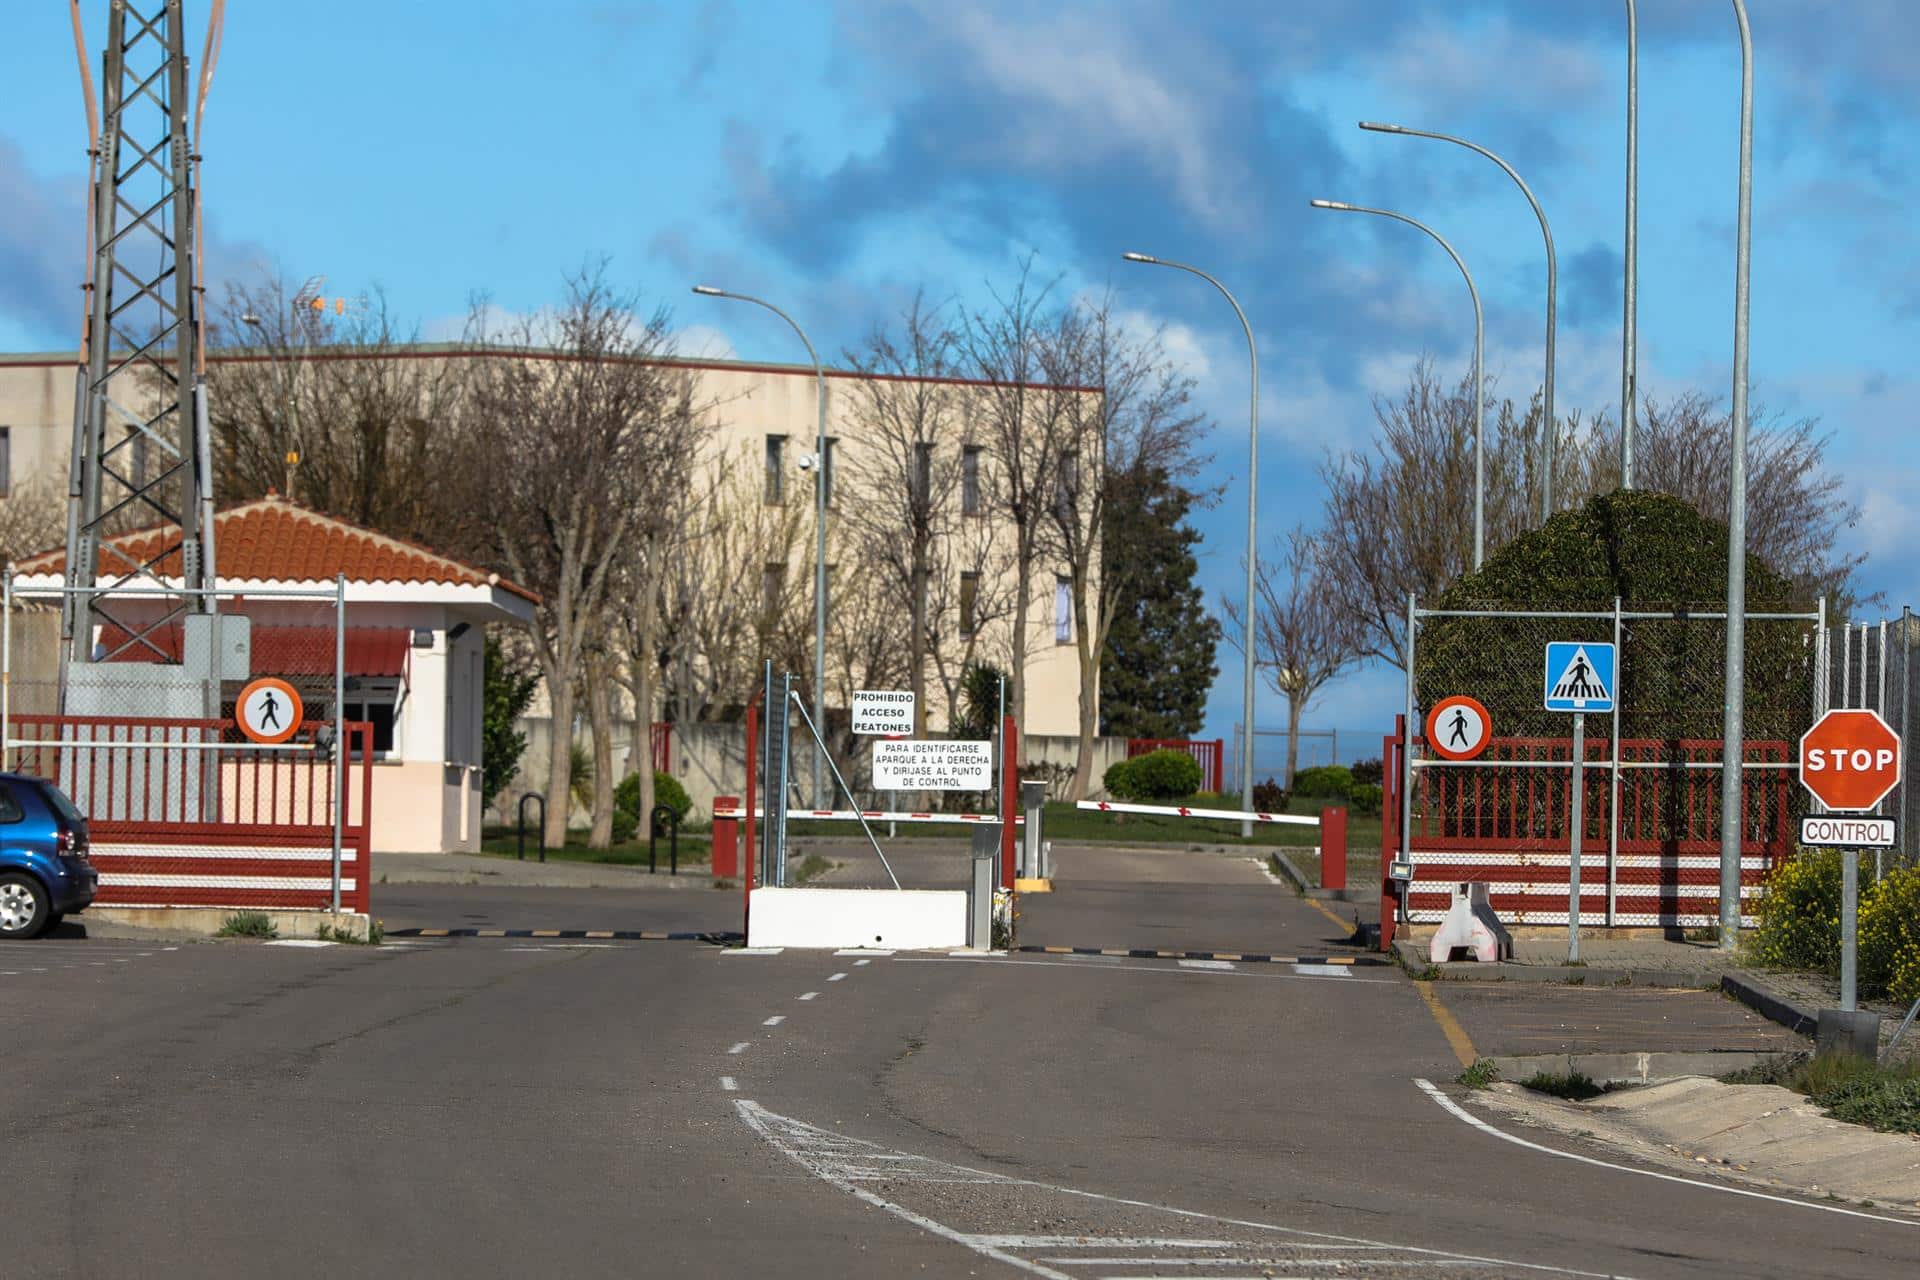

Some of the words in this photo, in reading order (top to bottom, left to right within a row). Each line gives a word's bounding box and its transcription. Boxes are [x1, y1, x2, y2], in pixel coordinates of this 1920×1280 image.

[854, 693, 913, 703] PROHIBIDO
[861, 708, 905, 717] ACCESO
[854, 723, 911, 732] PEATONES
[885, 744, 909, 752] PARA
[913, 744, 979, 753] IDENTIFICARSE
[876, 756, 917, 764] APARQUE
[921, 756, 927, 764] A
[931, 756, 943, 764] LA
[947, 756, 989, 764] DERECHA
[1807, 749, 1894, 771] STOP
[883, 767, 888, 775] Y
[893, 767, 932, 775] DIRIJASE
[936, 767, 948, 775] AL
[952, 767, 982, 776] PUNTO
[903, 778, 914, 786] DE
[918, 778, 961, 787] CONTROL
[1806, 822, 1891, 842] CONTROL
